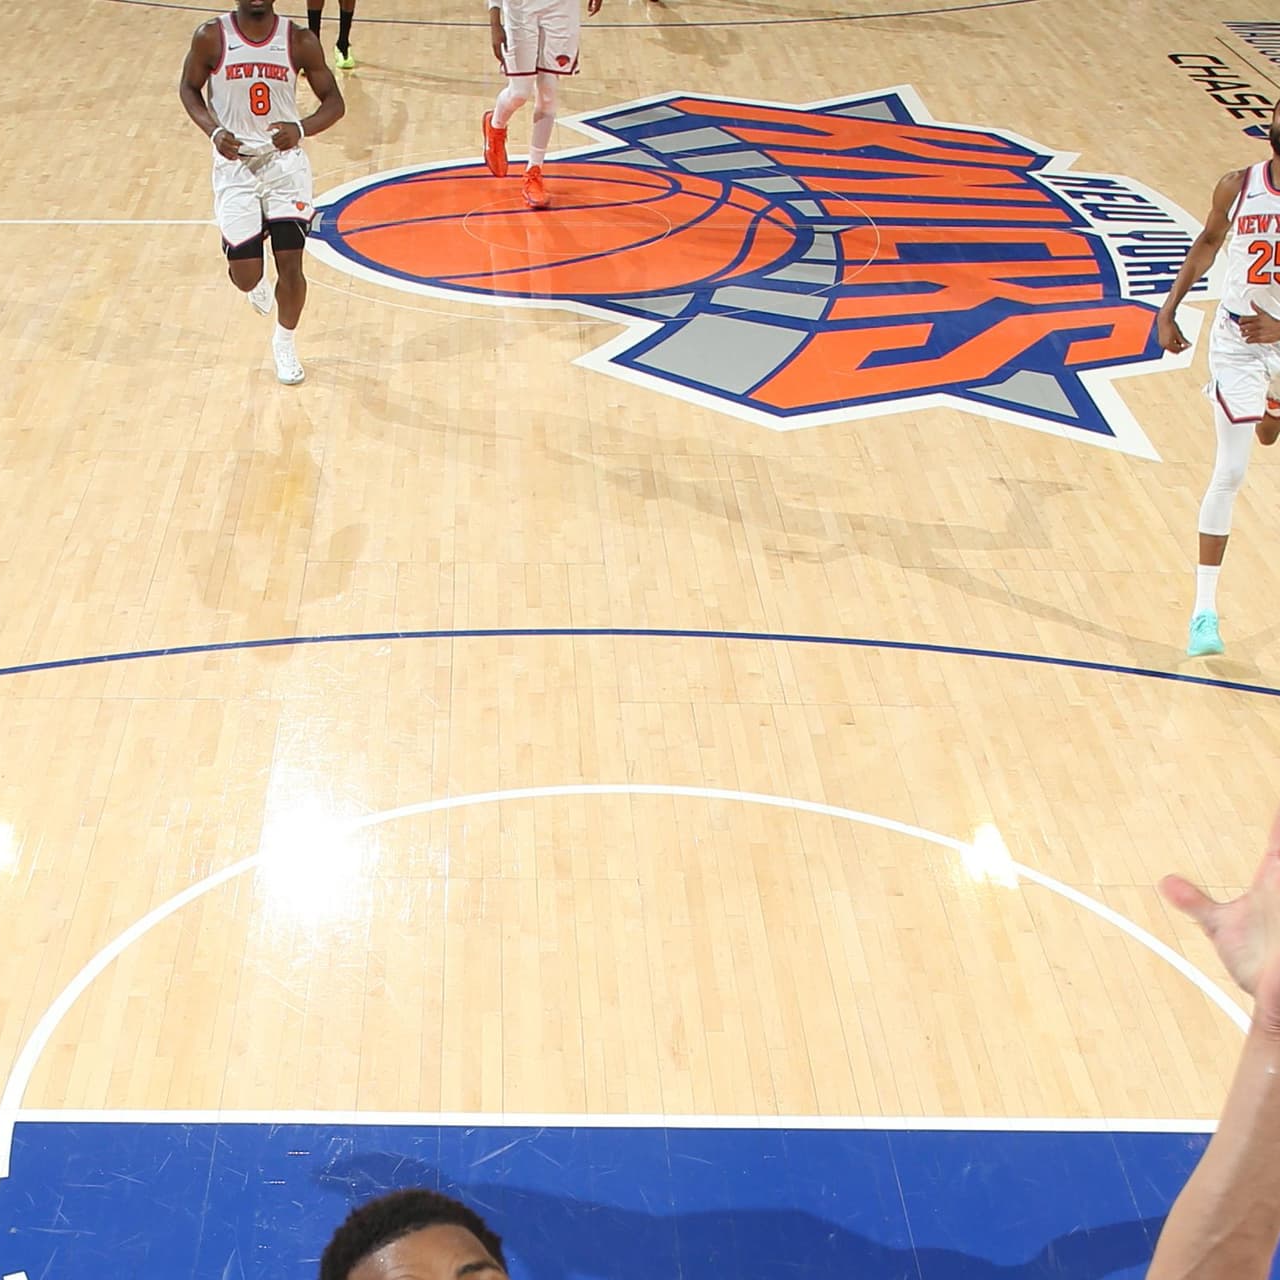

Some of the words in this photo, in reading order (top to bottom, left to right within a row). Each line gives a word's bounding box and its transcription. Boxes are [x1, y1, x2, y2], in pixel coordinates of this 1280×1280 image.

[225, 63, 254, 81] NEW
[254, 63, 289, 82] YORK
[1168, 53, 1274, 120] CHASE
[249, 81, 271, 116] 8
[1039, 173, 1177, 223] NEW
[1237, 213, 1271, 236] NEW
[667, 94, 1158, 409] KNICKS
[1107, 230, 1209, 296] YORK
